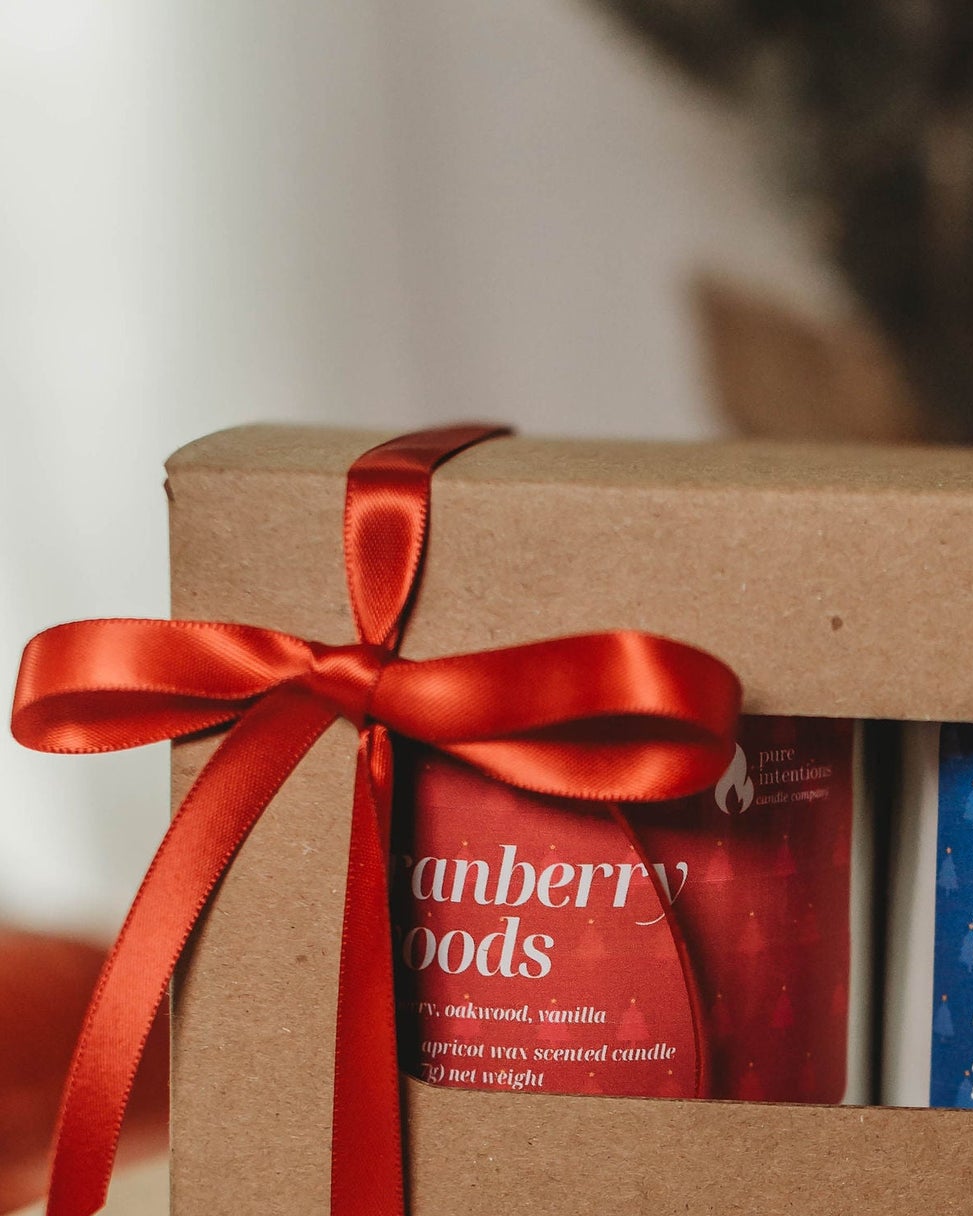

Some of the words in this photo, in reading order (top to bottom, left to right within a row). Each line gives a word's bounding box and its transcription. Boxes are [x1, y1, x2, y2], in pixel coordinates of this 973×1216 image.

[759, 748, 795, 768] pure
[759, 764, 833, 785] intentions
[790, 788, 830, 802] company
[402, 844, 688, 925] anberry
[397, 916, 555, 979] oods
[444, 1002, 533, 1024] oakwood,
[537, 1006, 606, 1024] vanilla
[421, 1040, 484, 1059] apricot
[489, 1045, 528, 1060] wax
[533, 1045, 607, 1063] scented
[611, 1043, 676, 1062] candle
[448, 1067, 477, 1084] net
[482, 1068, 544, 1090] weight
